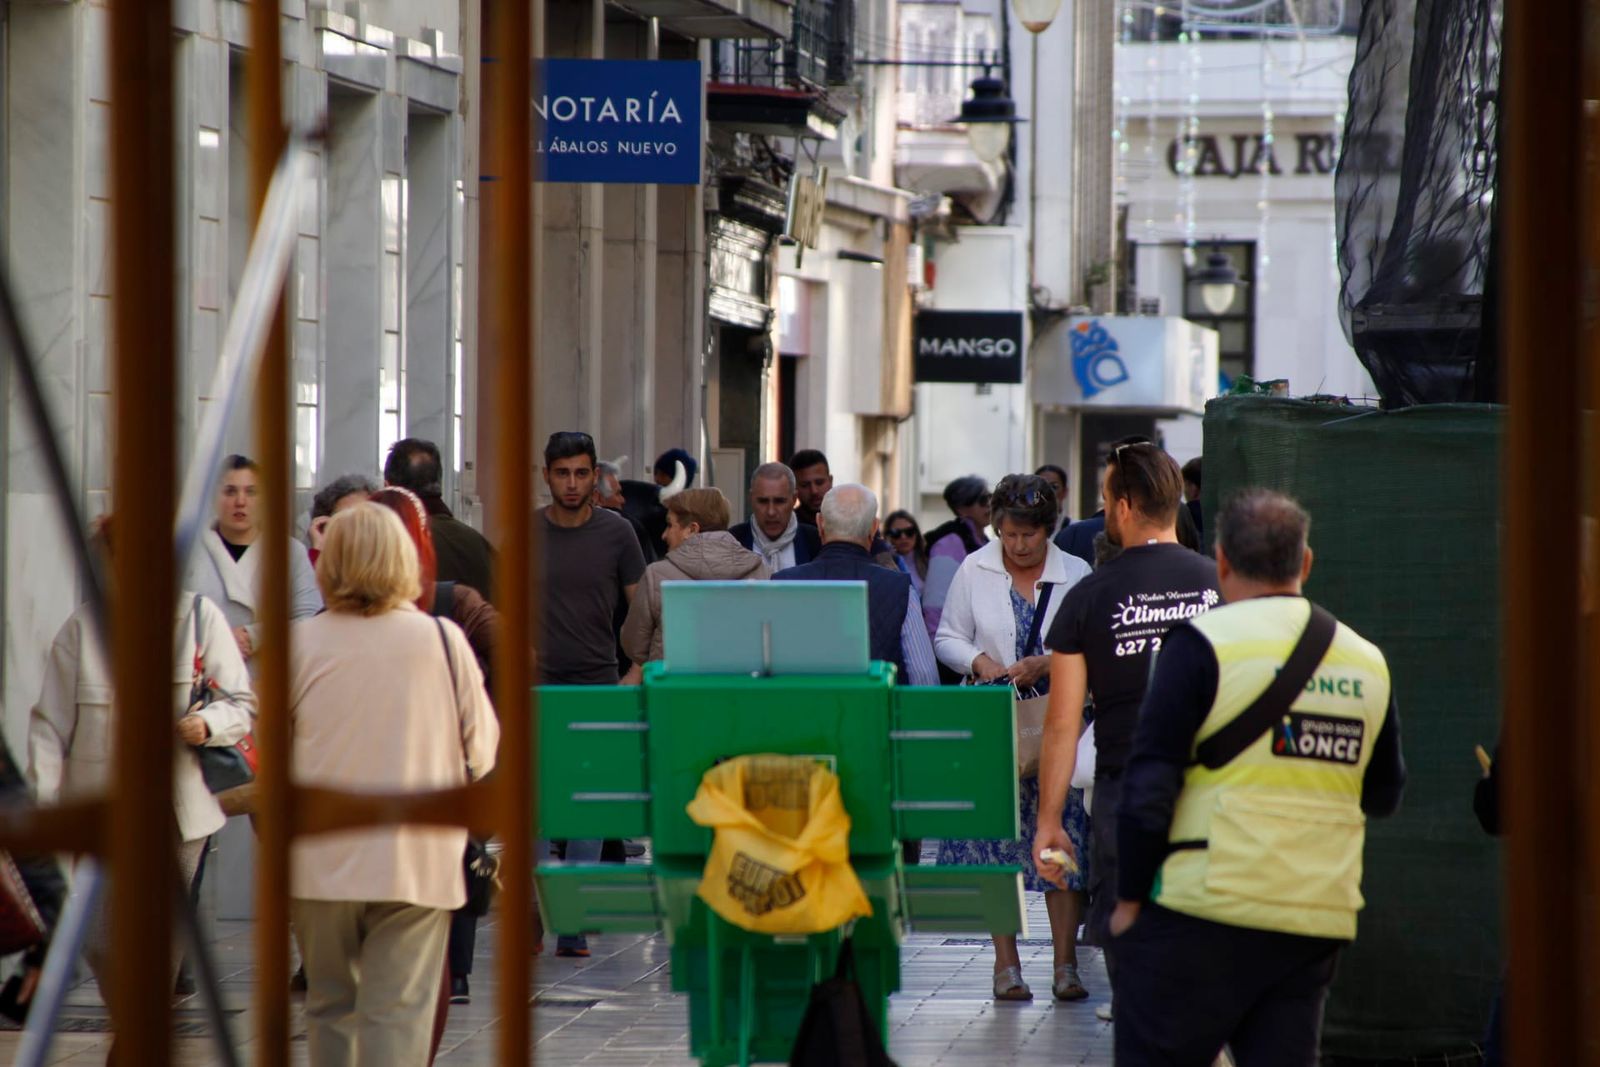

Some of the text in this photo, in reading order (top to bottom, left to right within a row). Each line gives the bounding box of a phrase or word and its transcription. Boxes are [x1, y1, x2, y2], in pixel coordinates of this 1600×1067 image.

[532, 90, 682, 123] NOTARÍA
[550, 136, 608, 153] ÁBALOS
[618, 141, 677, 155] NUEVO
[1167, 134, 1282, 178] CAJA
[919, 338, 1016, 357] MANGO
[1115, 638, 1147, 656] 627
[1304, 677, 1363, 698] ONCE
[1299, 733, 1359, 761] ONCE
